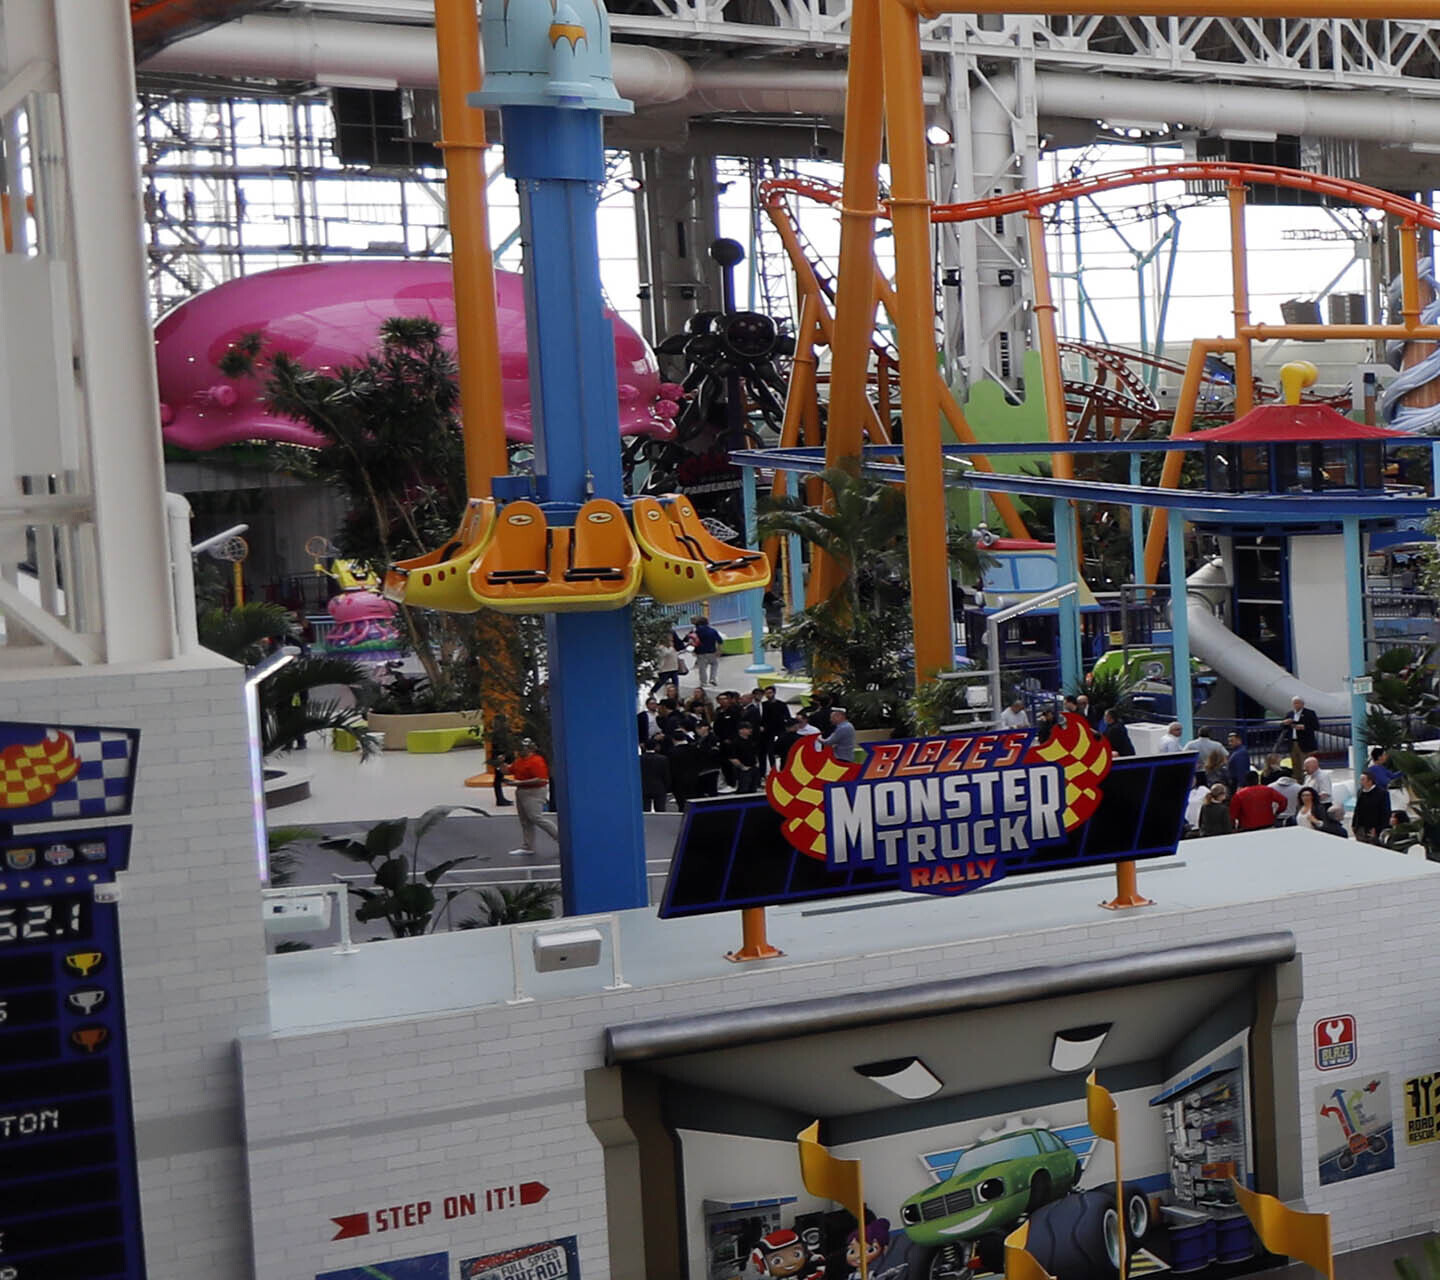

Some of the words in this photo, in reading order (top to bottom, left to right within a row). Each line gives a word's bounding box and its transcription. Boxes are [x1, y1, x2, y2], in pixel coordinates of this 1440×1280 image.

[863, 732, 1028, 779] BLAZE'S
[831, 765, 1061, 864] MONSTER
[877, 815, 1030, 866] TRUCK
[911, 859, 997, 888] RALLY
[1322, 1045, 1350, 1061] BLAZE
[1409, 1116, 1434, 1132] ROAD
[1409, 1129, 1436, 1142] RESCUE
[376, 1201, 431, 1233] STEP
[444, 1193, 477, 1220] ON
[486, 1186, 516, 1212] IT!
[501, 1261, 525, 1277] FULL
[528, 1249, 559, 1267] SPEED
